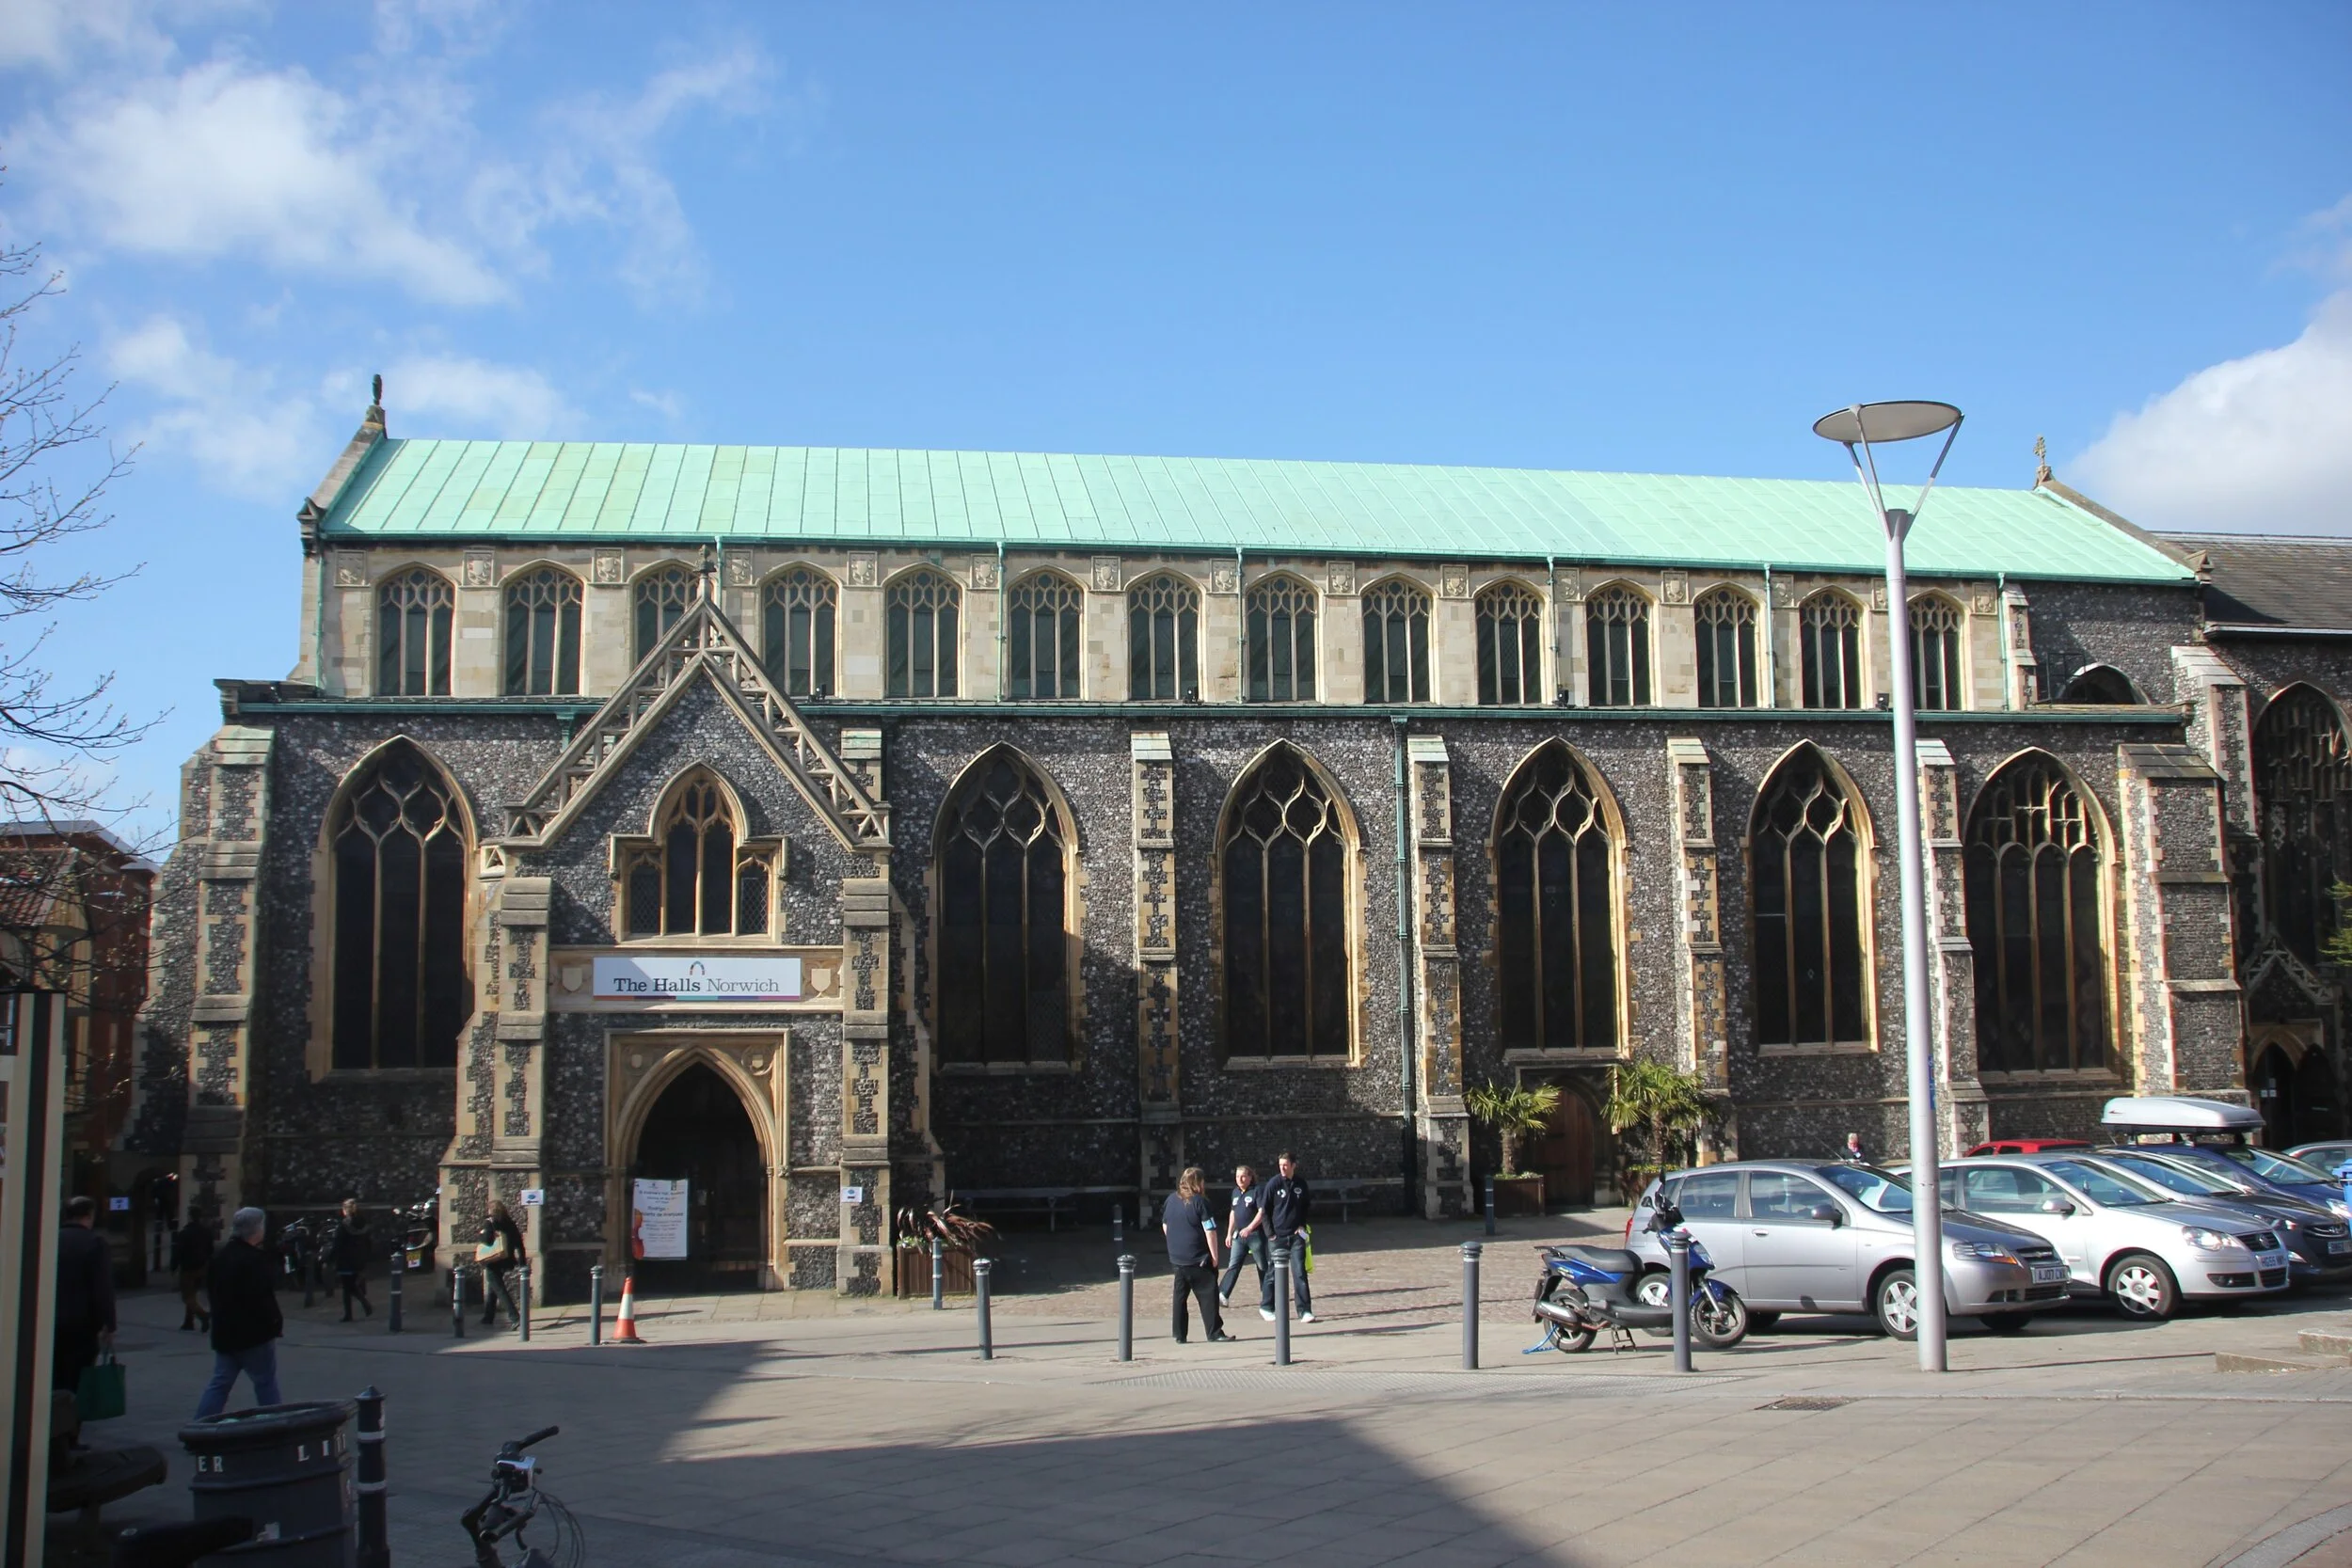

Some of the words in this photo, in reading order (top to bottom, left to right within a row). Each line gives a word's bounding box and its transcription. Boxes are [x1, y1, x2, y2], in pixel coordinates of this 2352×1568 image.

[613, 977, 647, 992] The
[652, 977, 701, 992] Halls
[707, 977, 779, 992] Norwich
